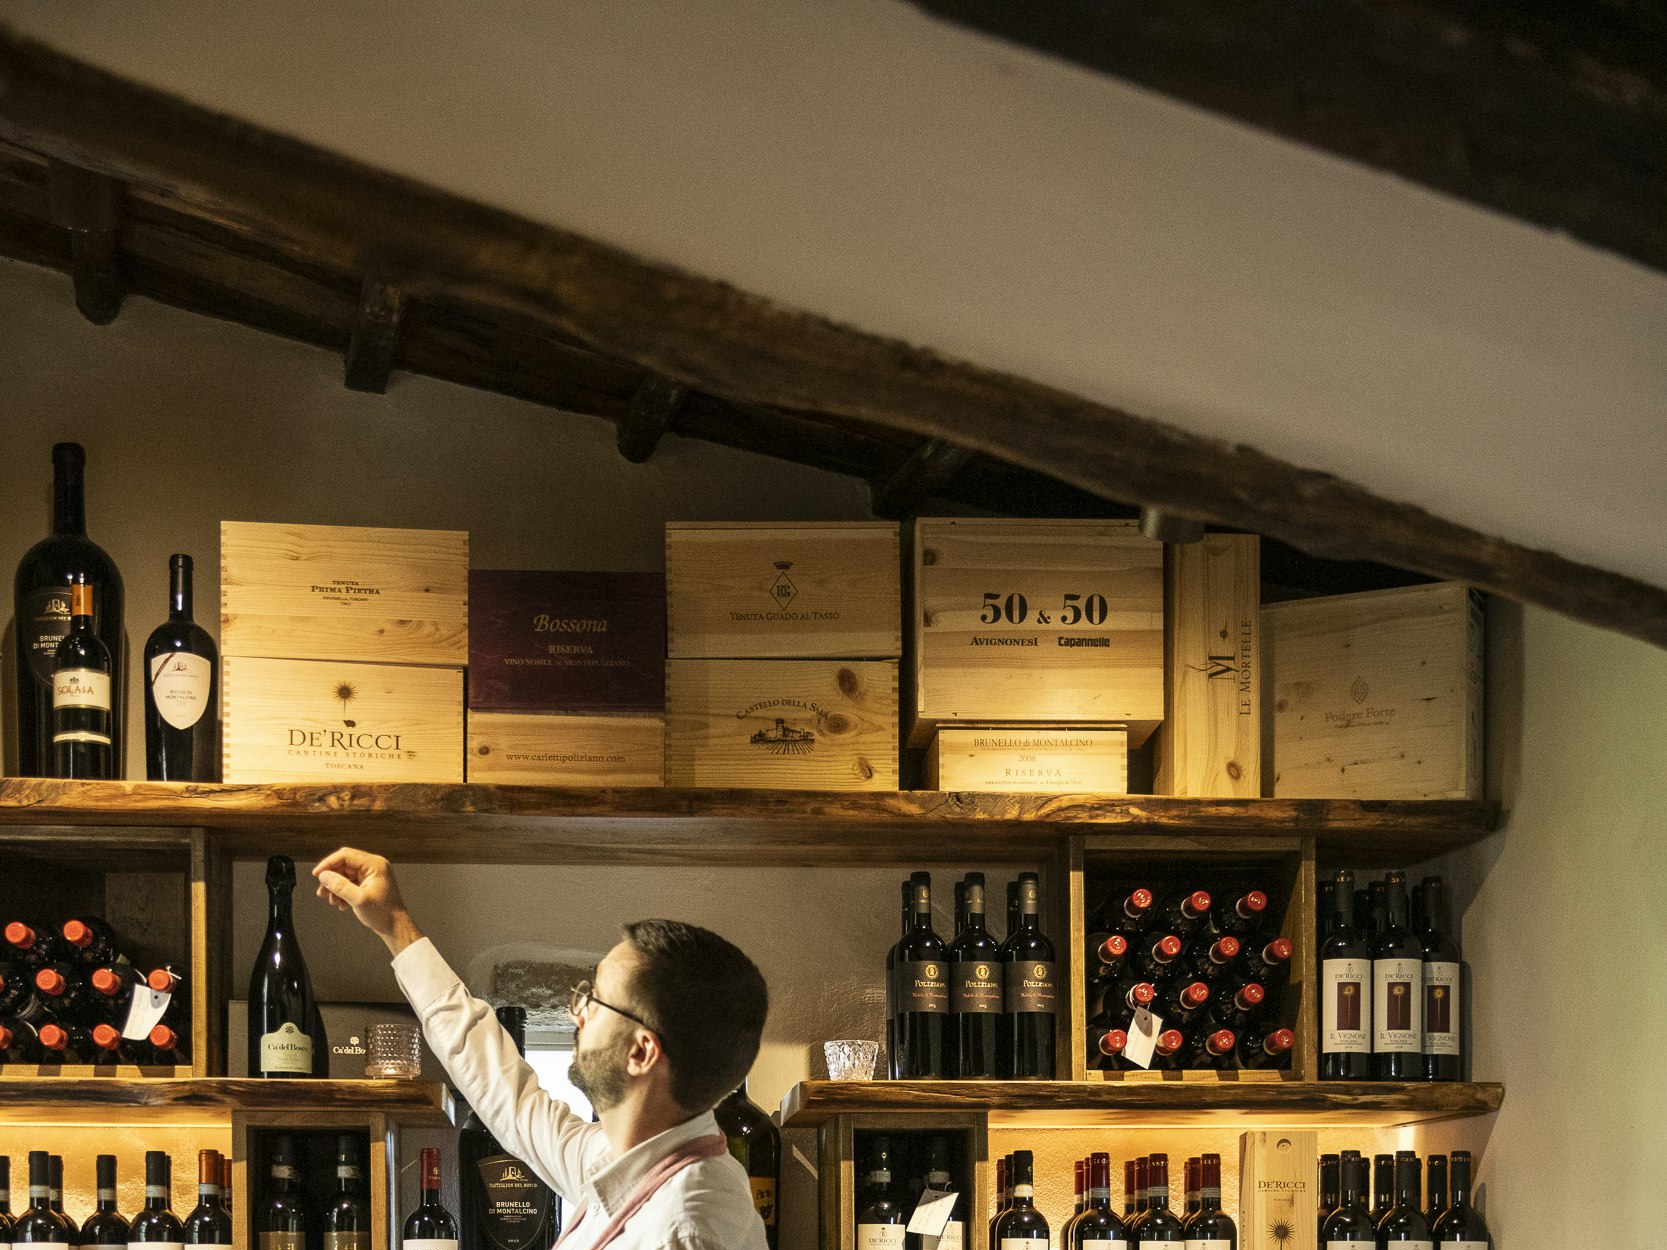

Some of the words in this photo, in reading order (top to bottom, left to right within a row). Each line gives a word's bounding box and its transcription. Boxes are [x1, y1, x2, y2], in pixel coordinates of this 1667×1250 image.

[310, 585, 343, 594] PRIMA
[345, 586, 381, 595] PIETRA
[980, 592, 1028, 624] 50
[1036, 609, 1051, 625] &
[1060, 593, 1108, 626] 50
[729, 612, 764, 621] TENUTA
[766, 612, 799, 621] GUADO
[800, 612, 811, 620] AL
[811, 611, 840, 620] TASSO
[533, 614, 609, 633] Bossona
[32, 642, 40, 650] DI
[970, 636, 1039, 647] AVIGNONESI
[1057, 636, 1110, 648] Capannelle
[549, 645, 594, 654] RISERVA
[1240, 620, 1251, 693] MORTELLE
[504, 658, 525, 666] VINO
[57, 685, 94, 696] SOLAIA
[736, 699, 780, 720] CASTELLO
[780, 699, 807, 710] DELLA
[808, 702, 829, 721] SALA
[1240, 699, 1251, 716] LE
[1325, 711, 1364, 723] Podere
[1365, 707, 1396, 718] Forte
[287, 729, 402, 751] DE'RICCI
[974, 738, 1022, 747] BRUNELLO
[1023, 738, 1031, 747] di
[1032, 738, 1093, 747] MONTALCINO
[287, 750, 339, 758] CANTINE
[345, 751, 402, 760] STORICHE
[325, 762, 364, 770] TOSCANA
[1005, 768, 1062, 777] RISERVA
[1338, 1032, 1366, 1040] VIGNONE
[1388, 1032, 1417, 1040] VIGNONE
[1257, 1180, 1306, 1190] DE'RICCI
